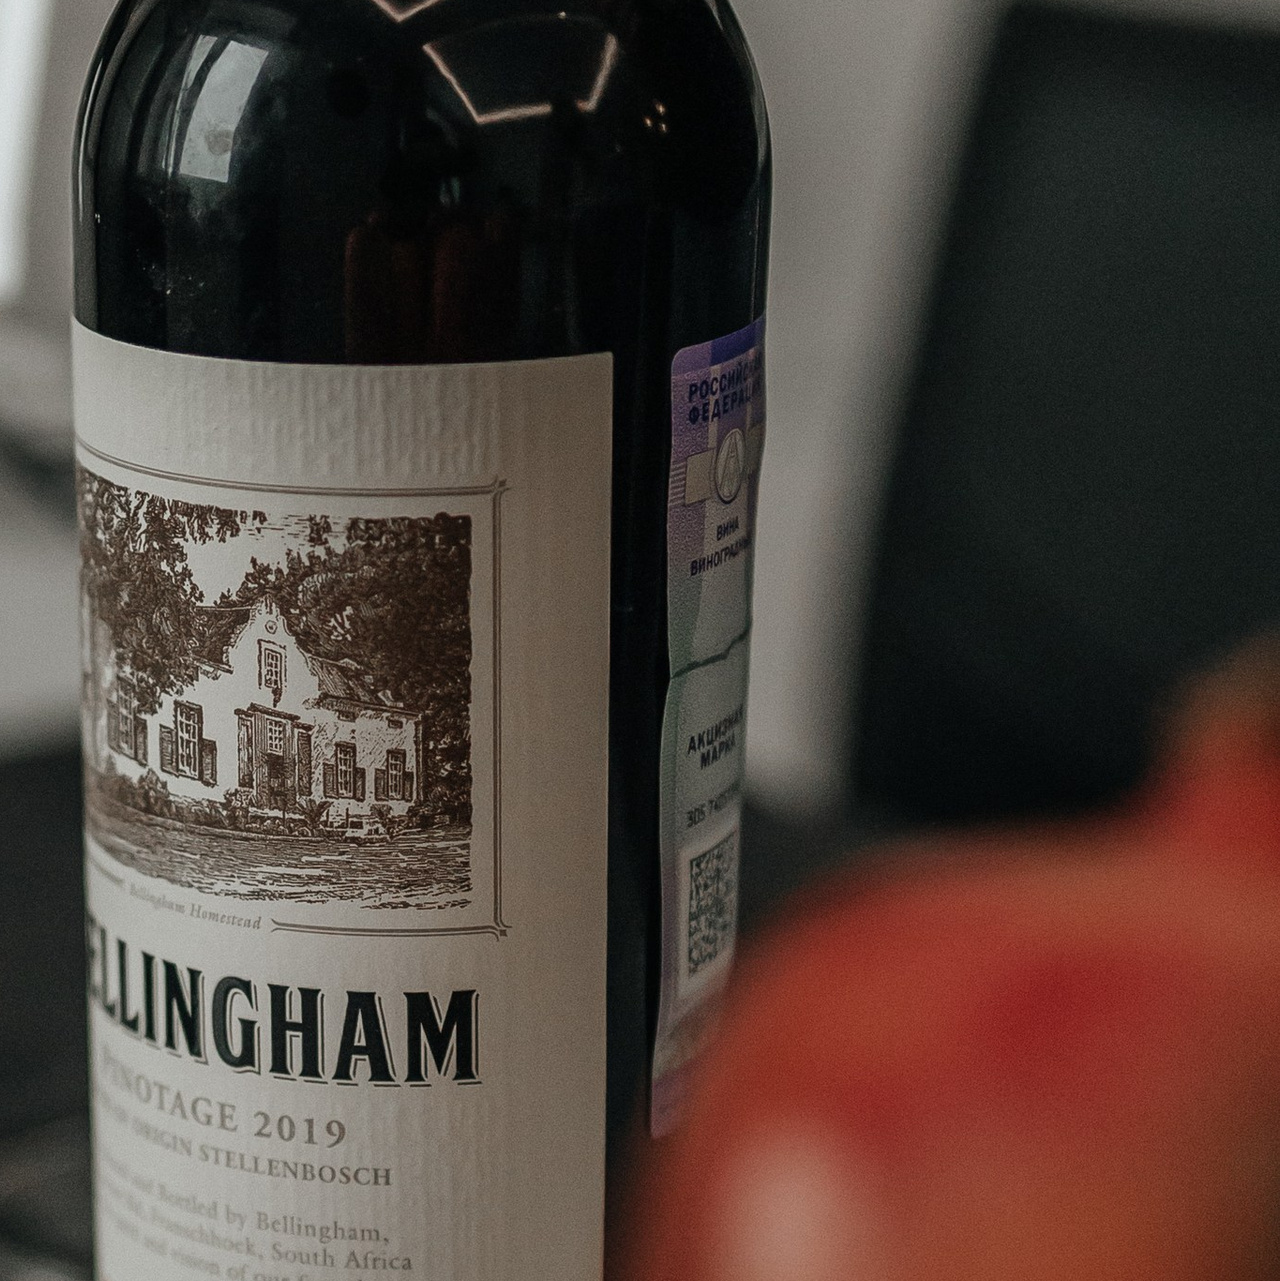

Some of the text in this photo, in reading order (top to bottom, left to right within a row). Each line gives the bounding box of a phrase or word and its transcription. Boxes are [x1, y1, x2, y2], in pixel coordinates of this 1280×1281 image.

[189, 902, 263, 931] Homestead
[253, 1110, 348, 1149] 2019
[197, 1144, 393, 1188] STELLENBOSCH
[224, 1204, 248, 1232] by
[256, 1211, 391, 1247] Bellingham,
[271, 1241, 335, 1270] South
[344, 1250, 414, 1273] Africa
